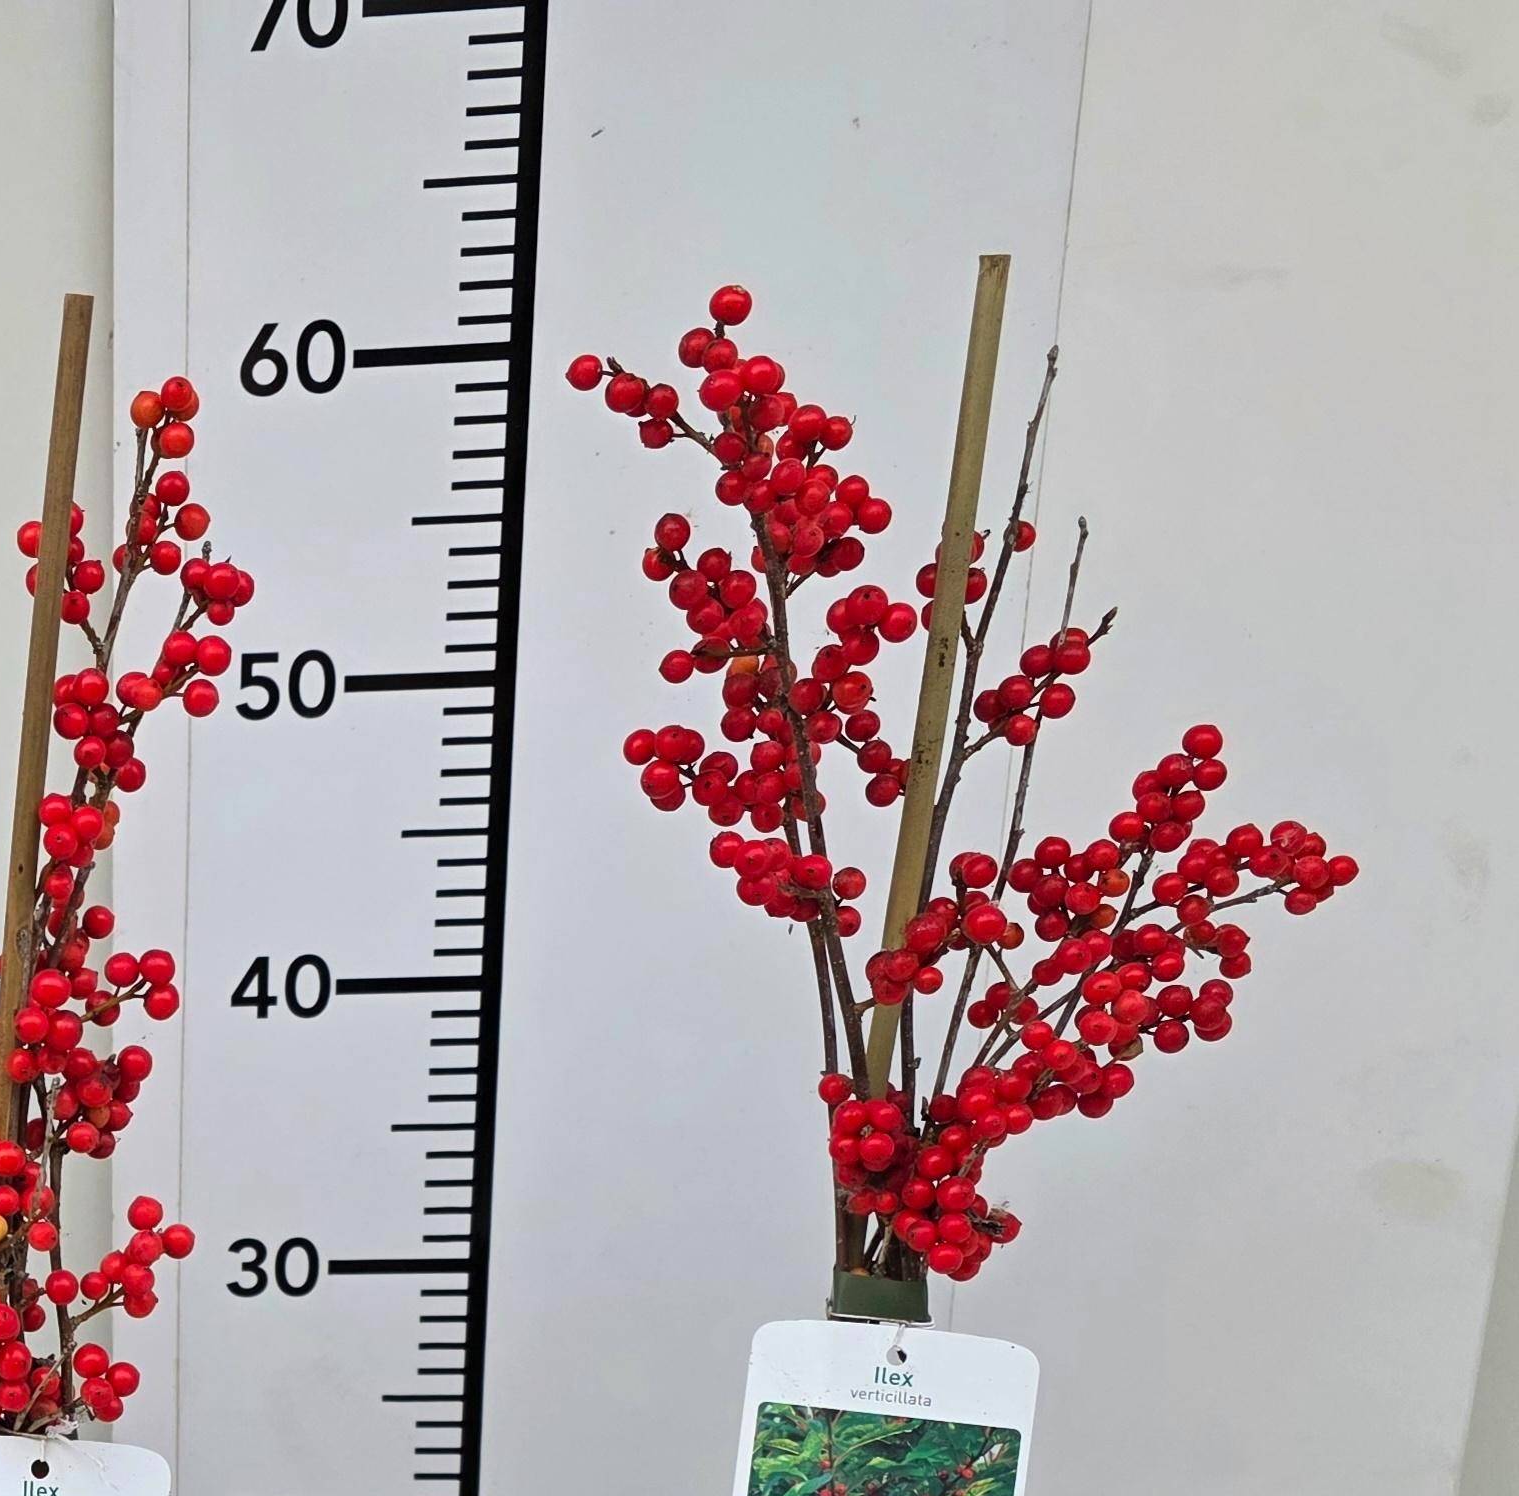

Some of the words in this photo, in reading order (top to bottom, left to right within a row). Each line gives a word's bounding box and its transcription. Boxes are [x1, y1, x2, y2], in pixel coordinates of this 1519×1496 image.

[239, 319, 346, 397] 60
[235, 649, 336, 721] 50
[230, 954, 331, 1019] 40
[226, 1237, 320, 1298] 30
[850, 1388, 932, 1407] verticillata
[874, 1366, 914, 1387] Ilex
